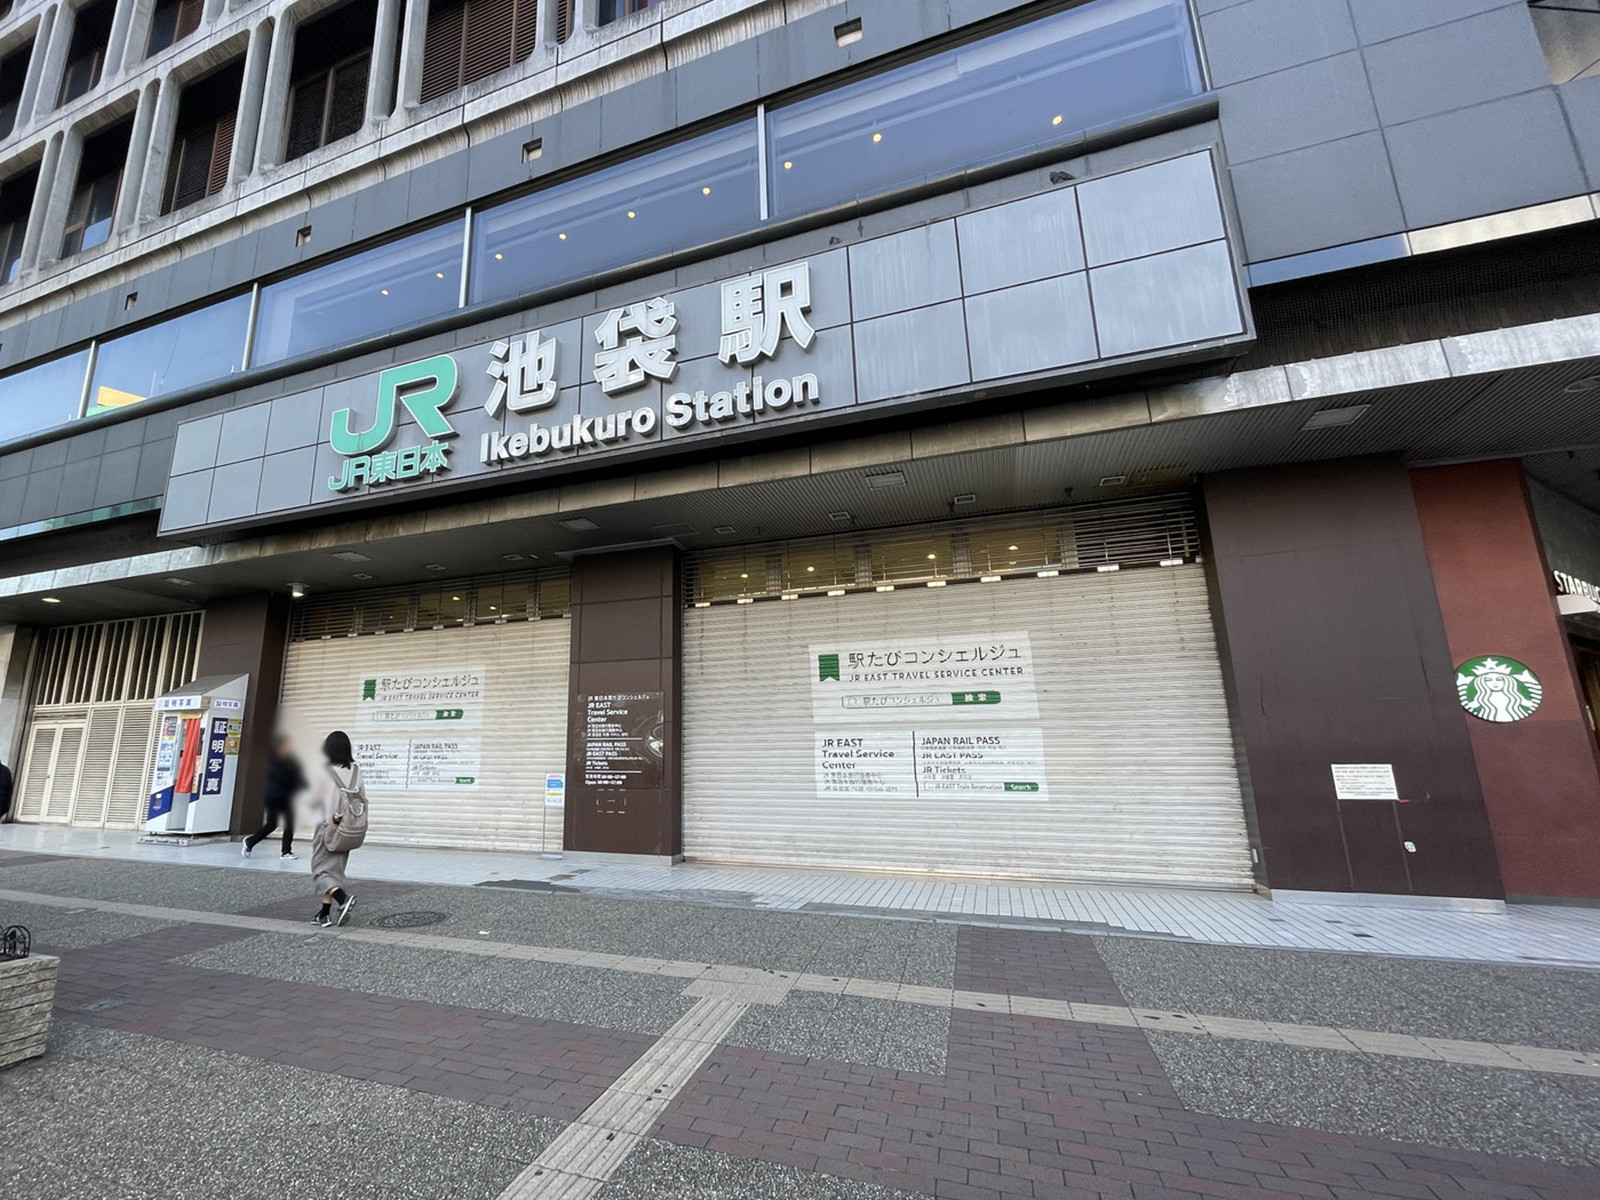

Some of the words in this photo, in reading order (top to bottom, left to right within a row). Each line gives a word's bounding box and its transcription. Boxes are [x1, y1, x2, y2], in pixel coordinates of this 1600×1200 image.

[484, 262, 817, 419] 池袋駅
[329, 354, 459, 458] JR
[480, 407, 656, 465] Ikebukuro
[667, 372, 820, 429] Station
[327, 439, 452, 494] JR東日本
[848, 644, 1023, 671] 駅たびコンシェルジュ
[849, 674, 861, 683] JR
[864, 673, 889, 683] EAST
[892, 670, 931, 681] TRAVEL
[934, 669, 978, 680] SERVICE
[981, 666, 1024, 677] CENTER
[822, 738, 834, 749] JR
[836, 738, 864, 748] EAST
[921, 737, 950, 746] JAPAN
[953, 736, 974, 746] RAIL
[976, 736, 1001, 745] PASS
[205, 720, 228, 792] 証明写真
[822, 750, 853, 758] Travel
[856, 749, 895, 758] Service
[821, 761, 857, 770] Center
[934, 766, 966, 774] Tickets
